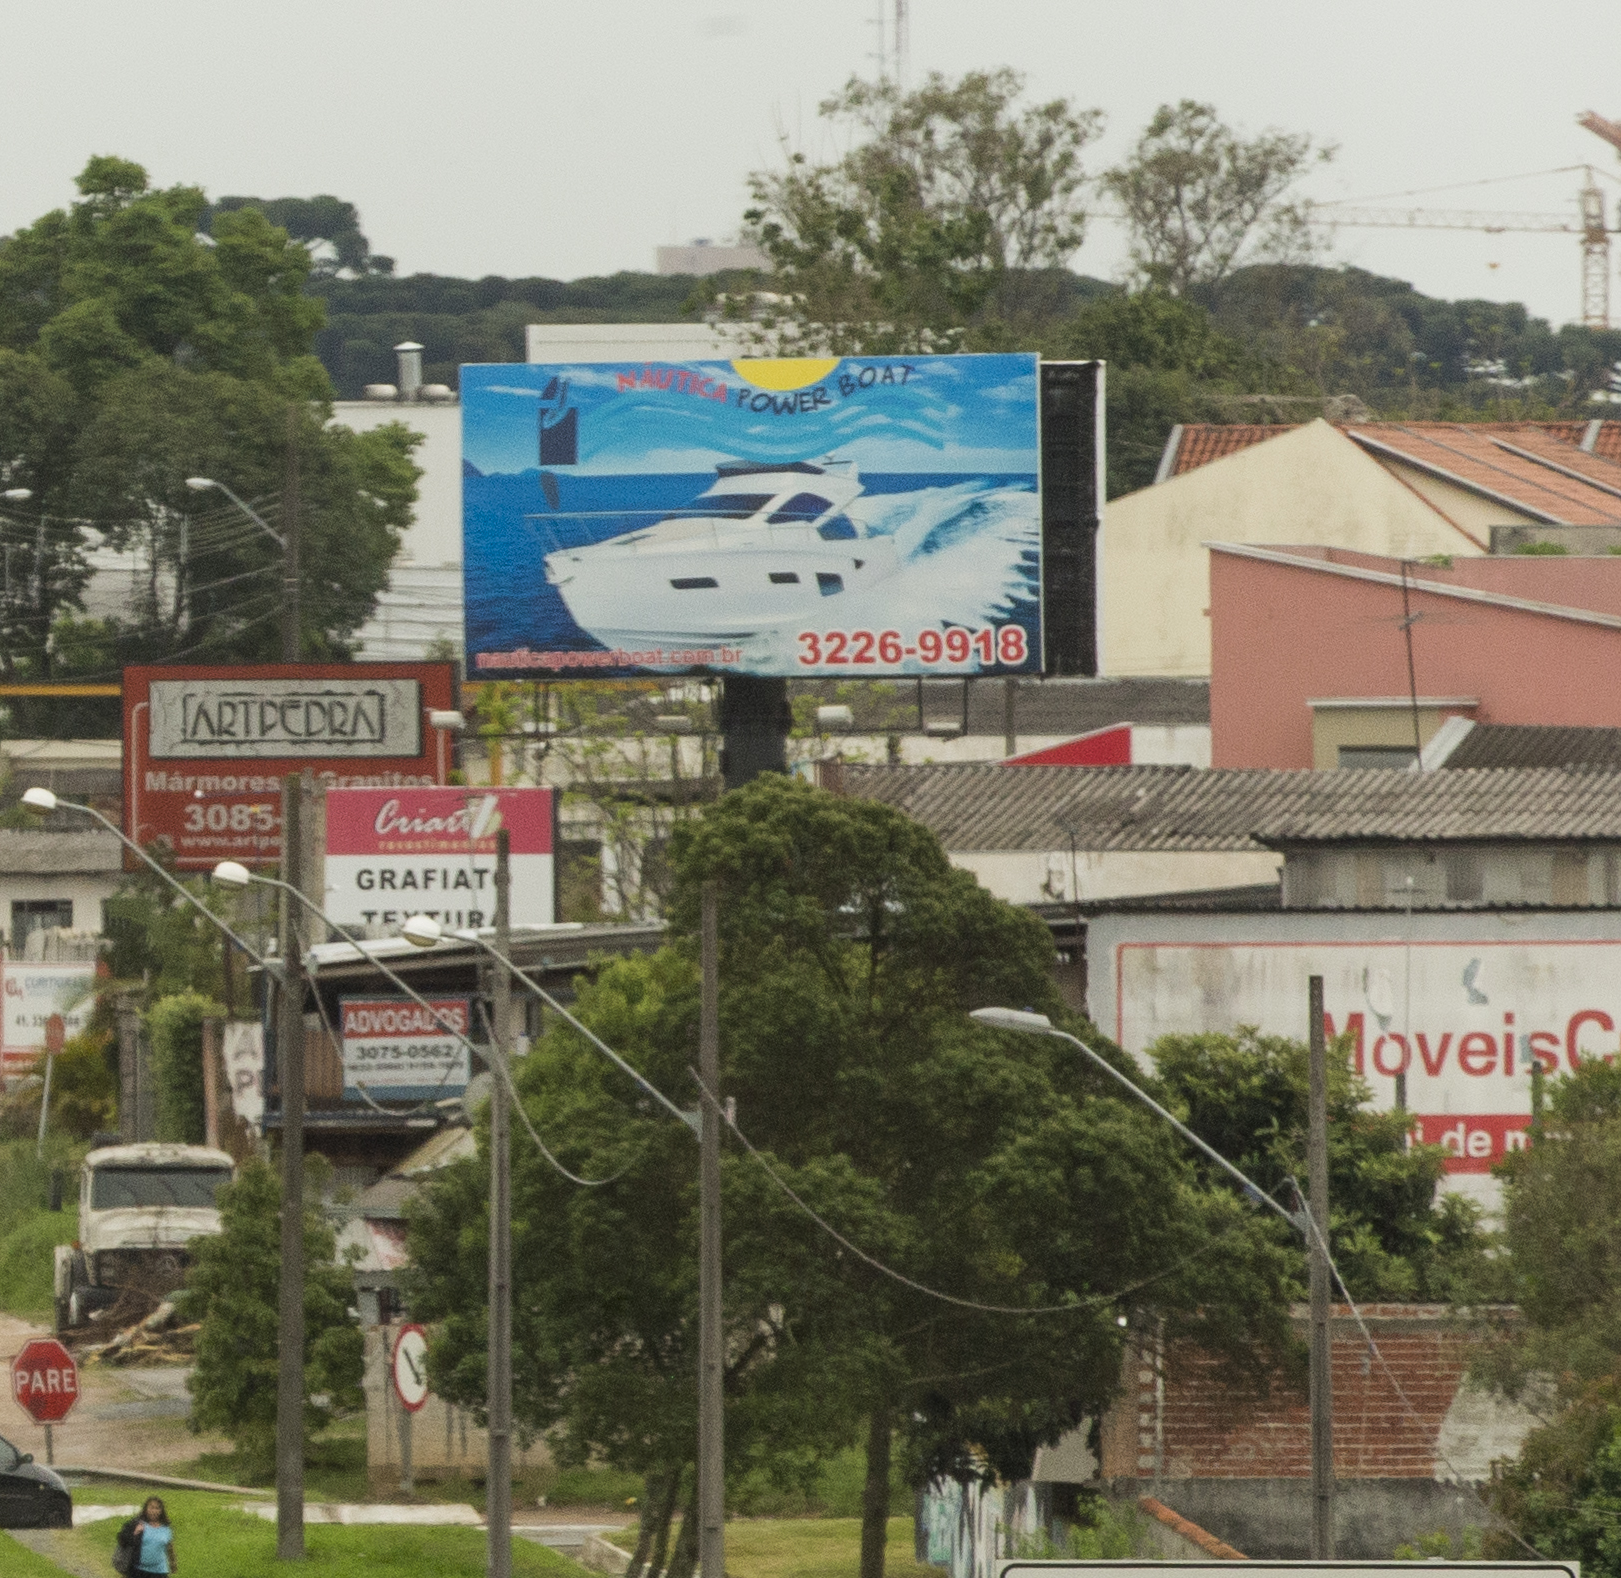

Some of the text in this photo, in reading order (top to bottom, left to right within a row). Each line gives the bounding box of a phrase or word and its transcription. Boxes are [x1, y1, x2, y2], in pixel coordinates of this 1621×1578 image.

[616, 361, 916, 416] NÁUTICA POWER BOAT
[797, 625, 1029, 667] 3226-9918
[189, 698, 379, 739] ARTPEDRA
[145, 770, 433, 793] Mármores Granitos
[356, 868, 511, 891] GRAFIAT
[1440, 1122, 1493, 1159] de
[15, 1369, 76, 1395] PARE
